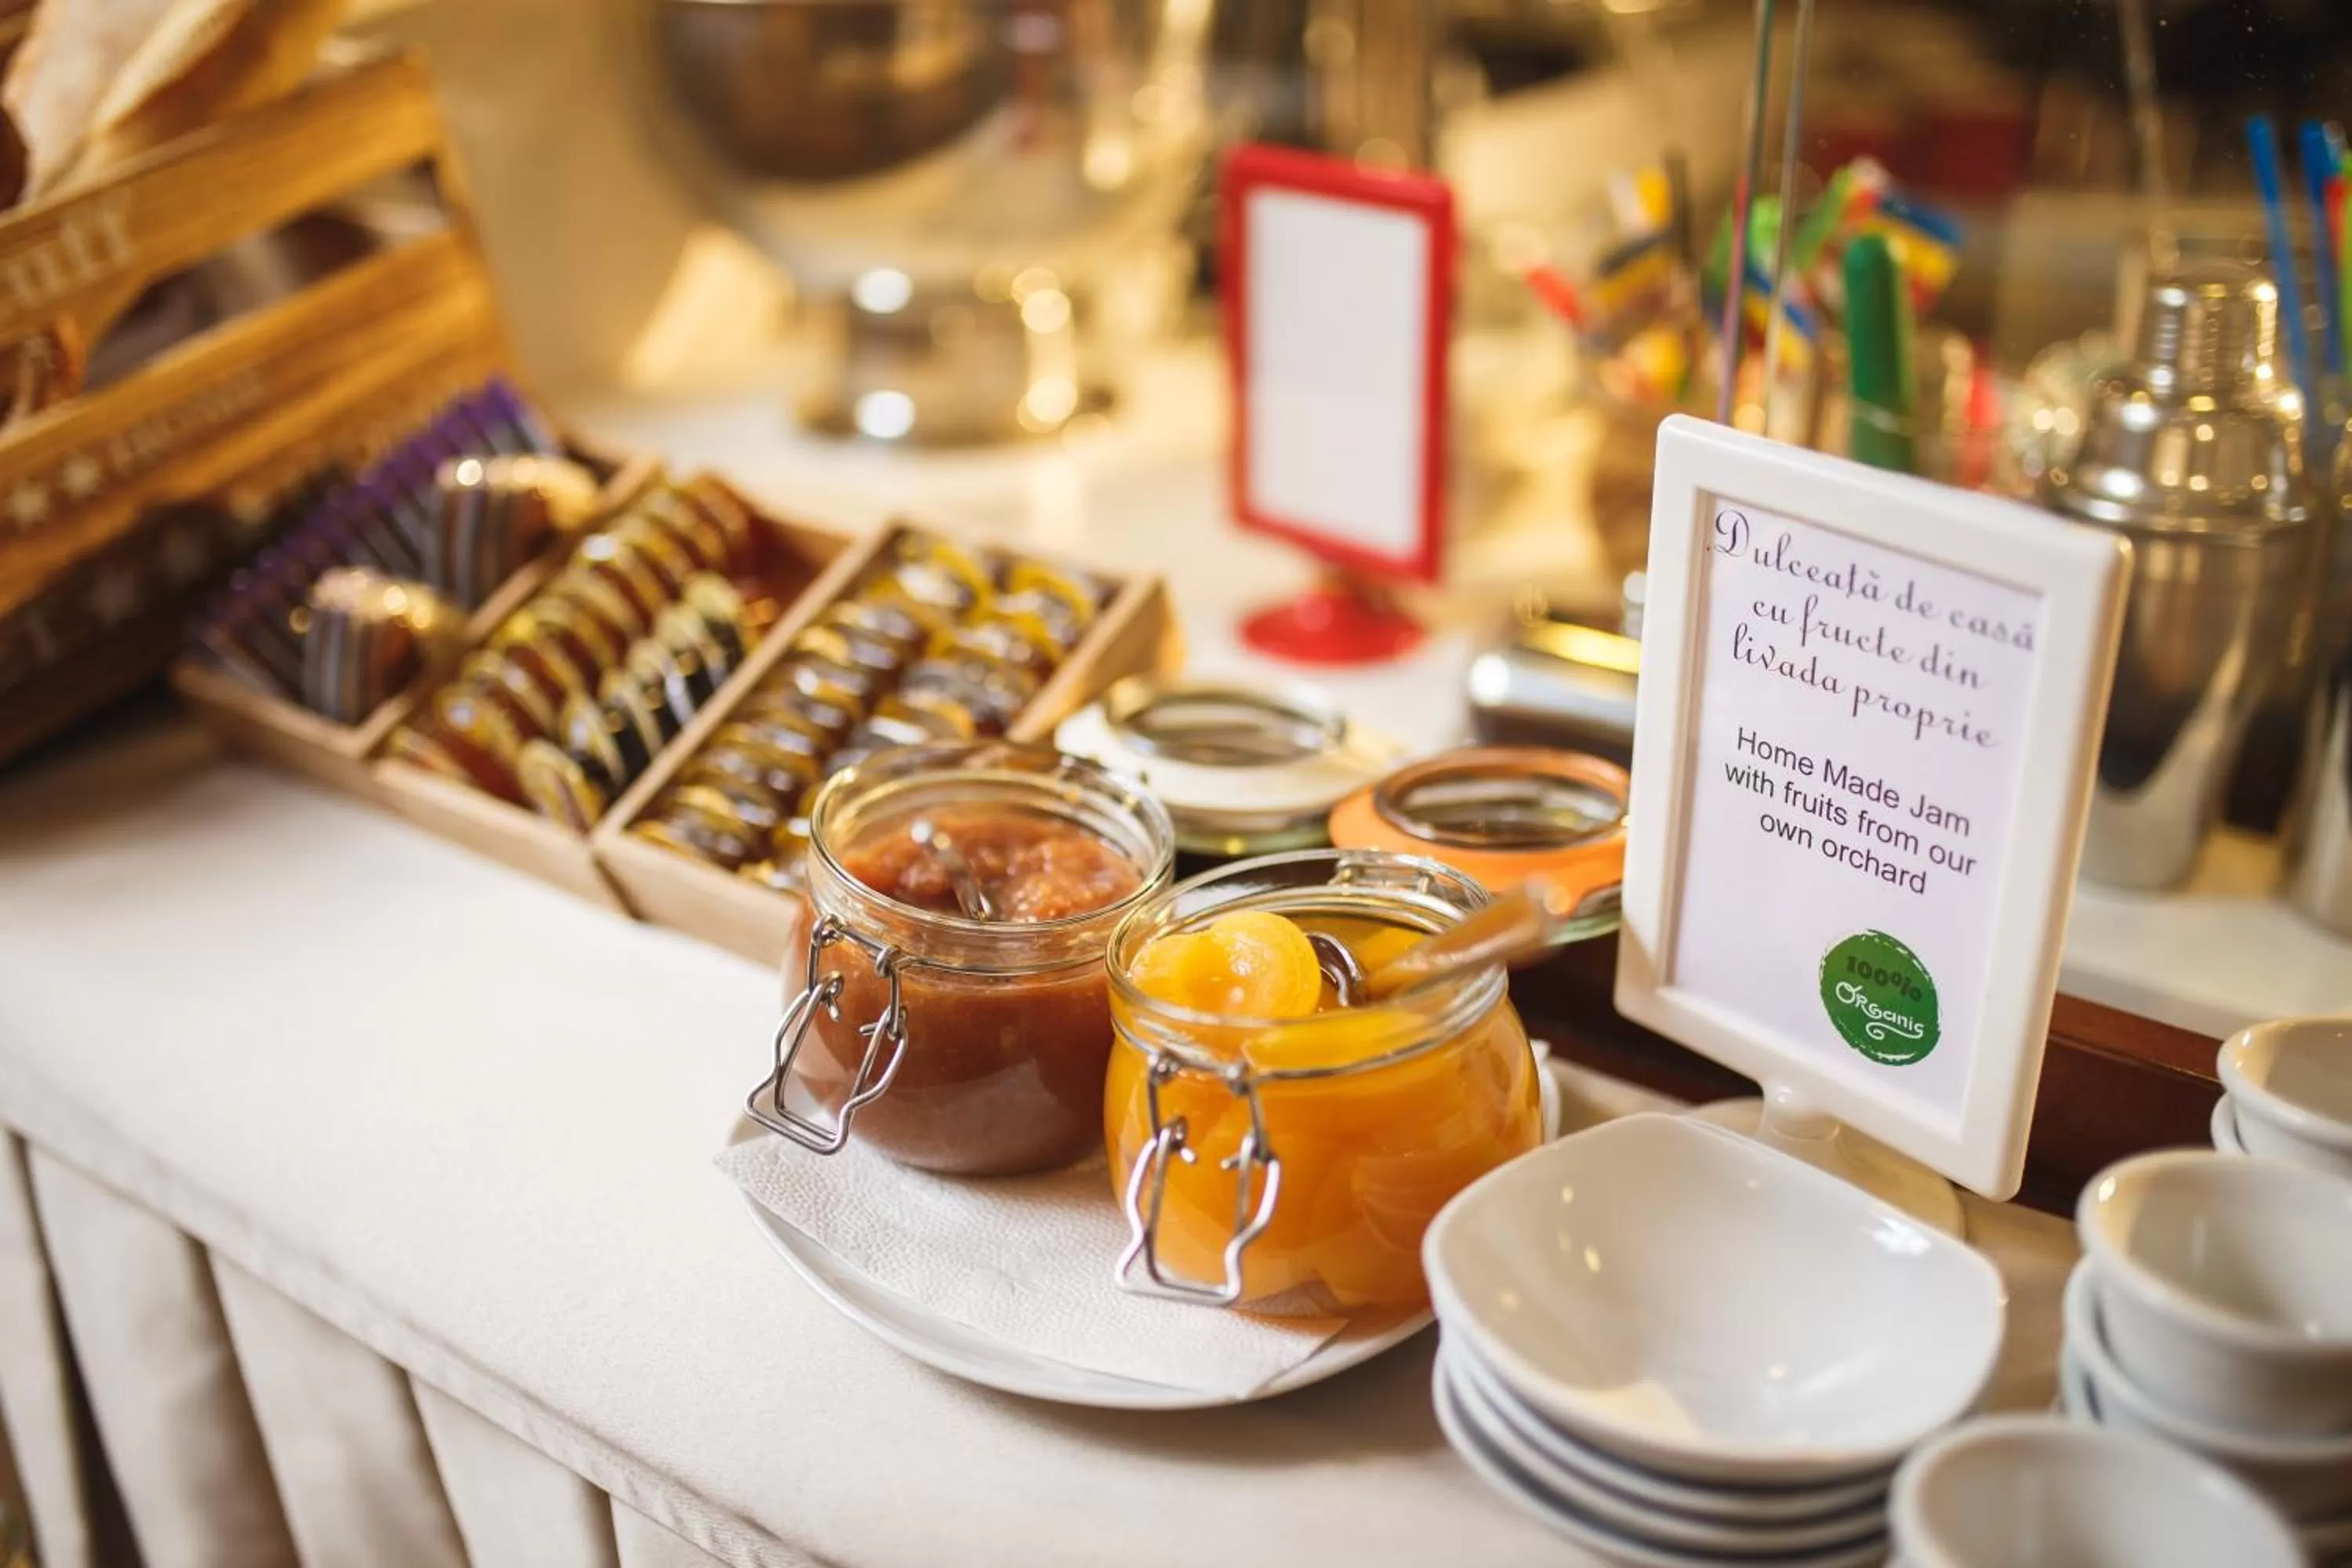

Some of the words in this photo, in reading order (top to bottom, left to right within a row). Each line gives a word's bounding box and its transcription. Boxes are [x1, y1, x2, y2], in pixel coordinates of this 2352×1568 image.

[1753, 601, 1794, 624] cu
[1799, 593, 1915, 663] fructe
[1920, 642, 1991, 689] din
[1895, 580, 1940, 619] de
[1733, 623, 1845, 693] livada
[1852, 681, 2003, 747] proprie
[1725, 763, 1774, 798] with
[1784, 781, 1847, 826] fruits
[1857, 811, 1918, 855] from
[1929, 843, 1976, 877] our
[1737, 727, 1813, 775] Home
[1823, 758, 1900, 808] Made
[1910, 797, 1970, 837] Jam
[1760, 812, 1812, 849] own
[1822, 838, 1927, 895] orchard
[1847, 956, 1922, 1003] 100%
